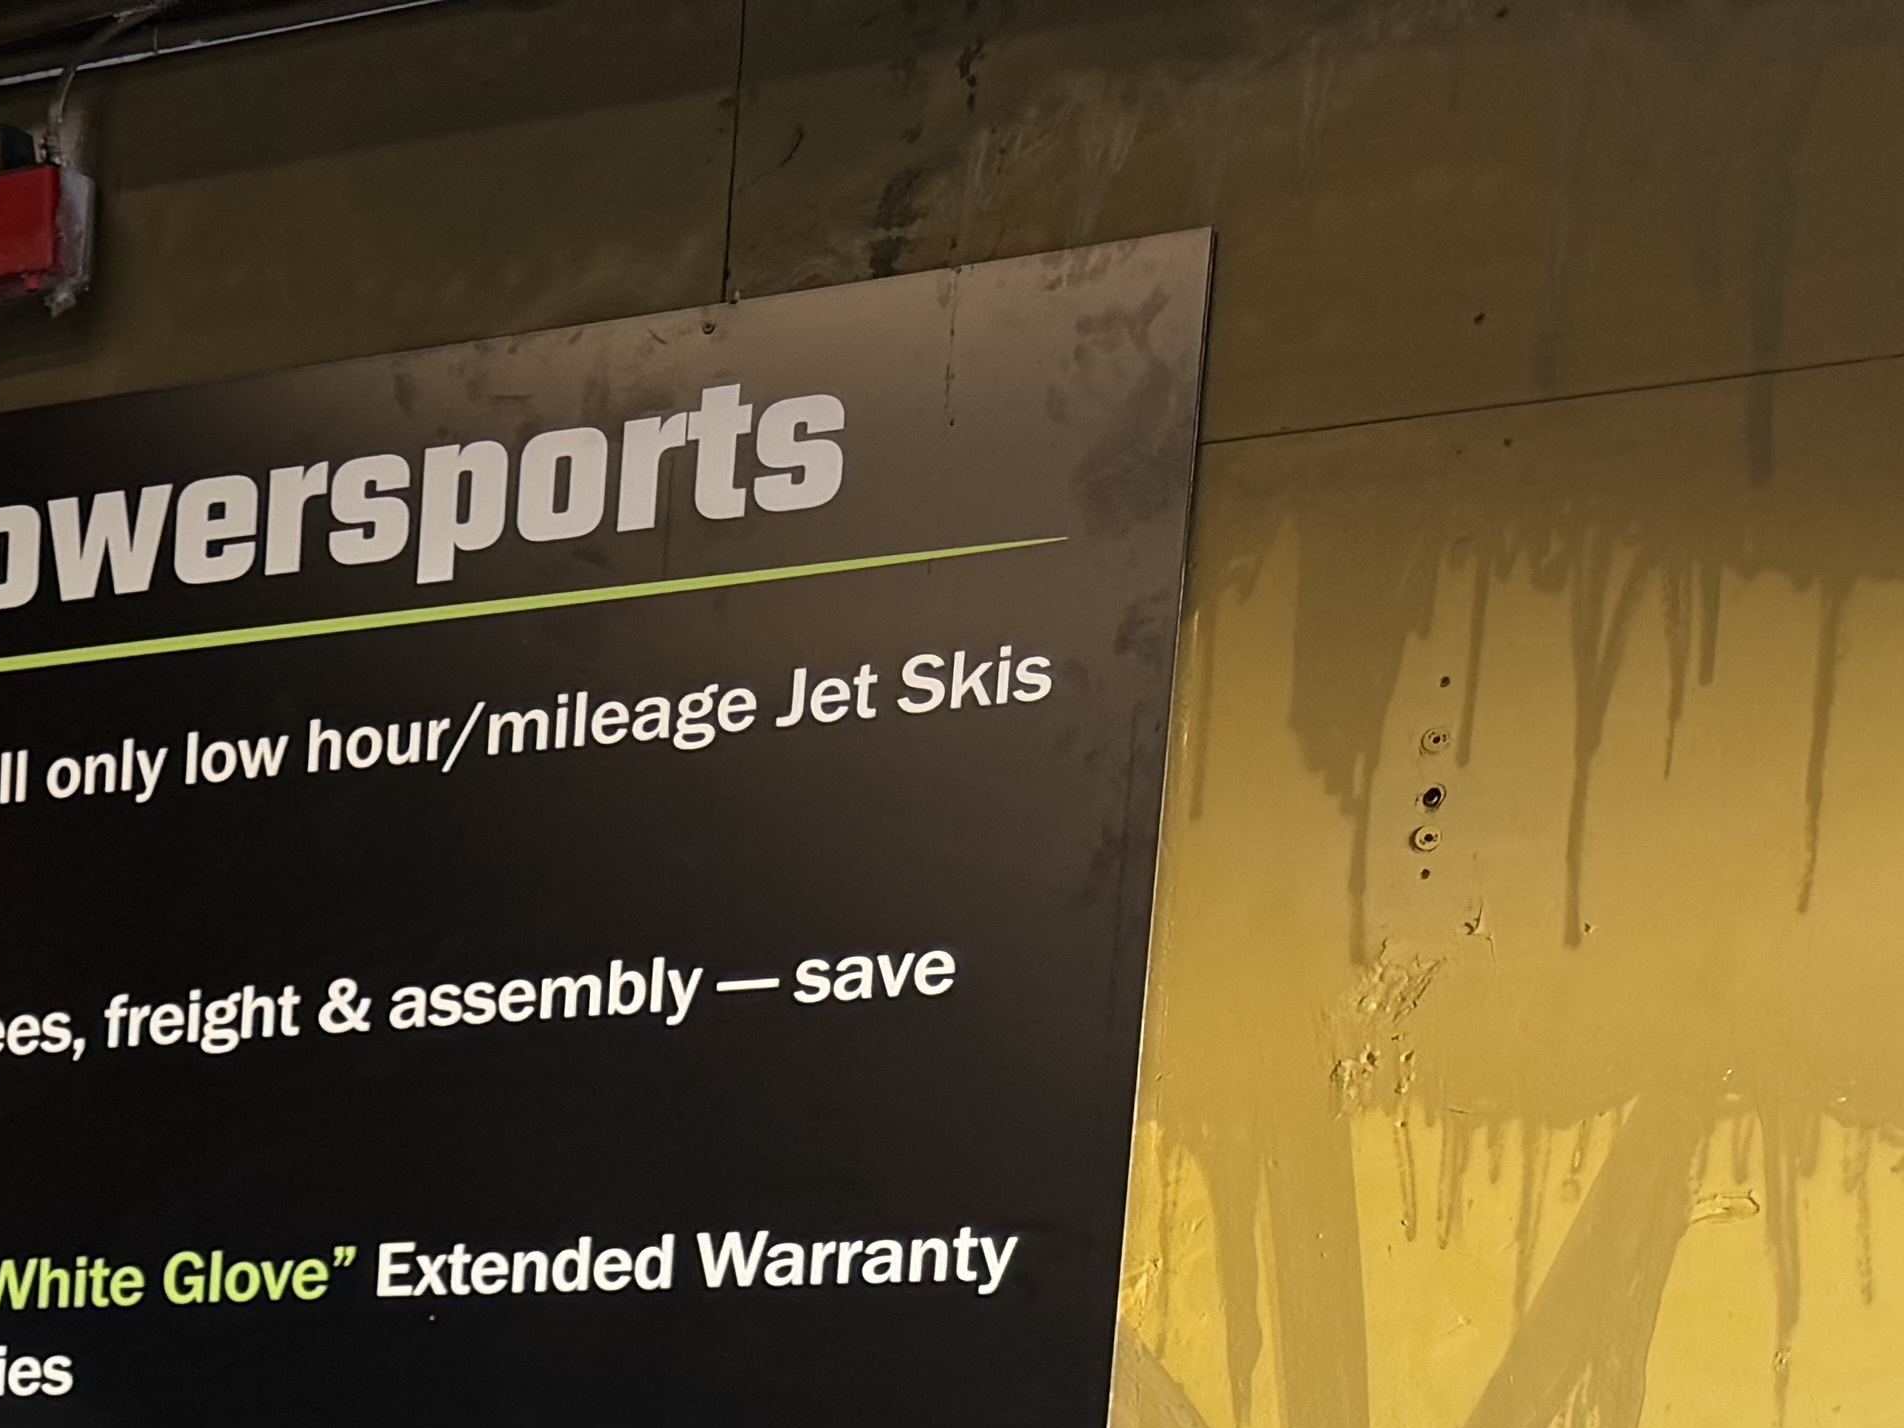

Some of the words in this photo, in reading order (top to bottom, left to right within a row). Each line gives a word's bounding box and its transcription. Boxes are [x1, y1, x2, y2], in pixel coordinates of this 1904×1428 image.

[46, 738, 169, 803] only
[185, 731, 289, 785] low
[307, 683, 757, 773] hour/mileage
[775, 663, 878, 728] Jet
[897, 645, 1052, 714] Skis
[104, 985, 301, 1054] freight
[318, 977, 372, 1034] &
[389, 956, 704, 1030] assembly
[716, 977, 780, 992] —
[793, 950, 956, 1004] save
[163, 1245, 357, 1305] Glove”
[376, 1233, 675, 1297] Extended
[696, 1226, 1019, 1295] Warranty
